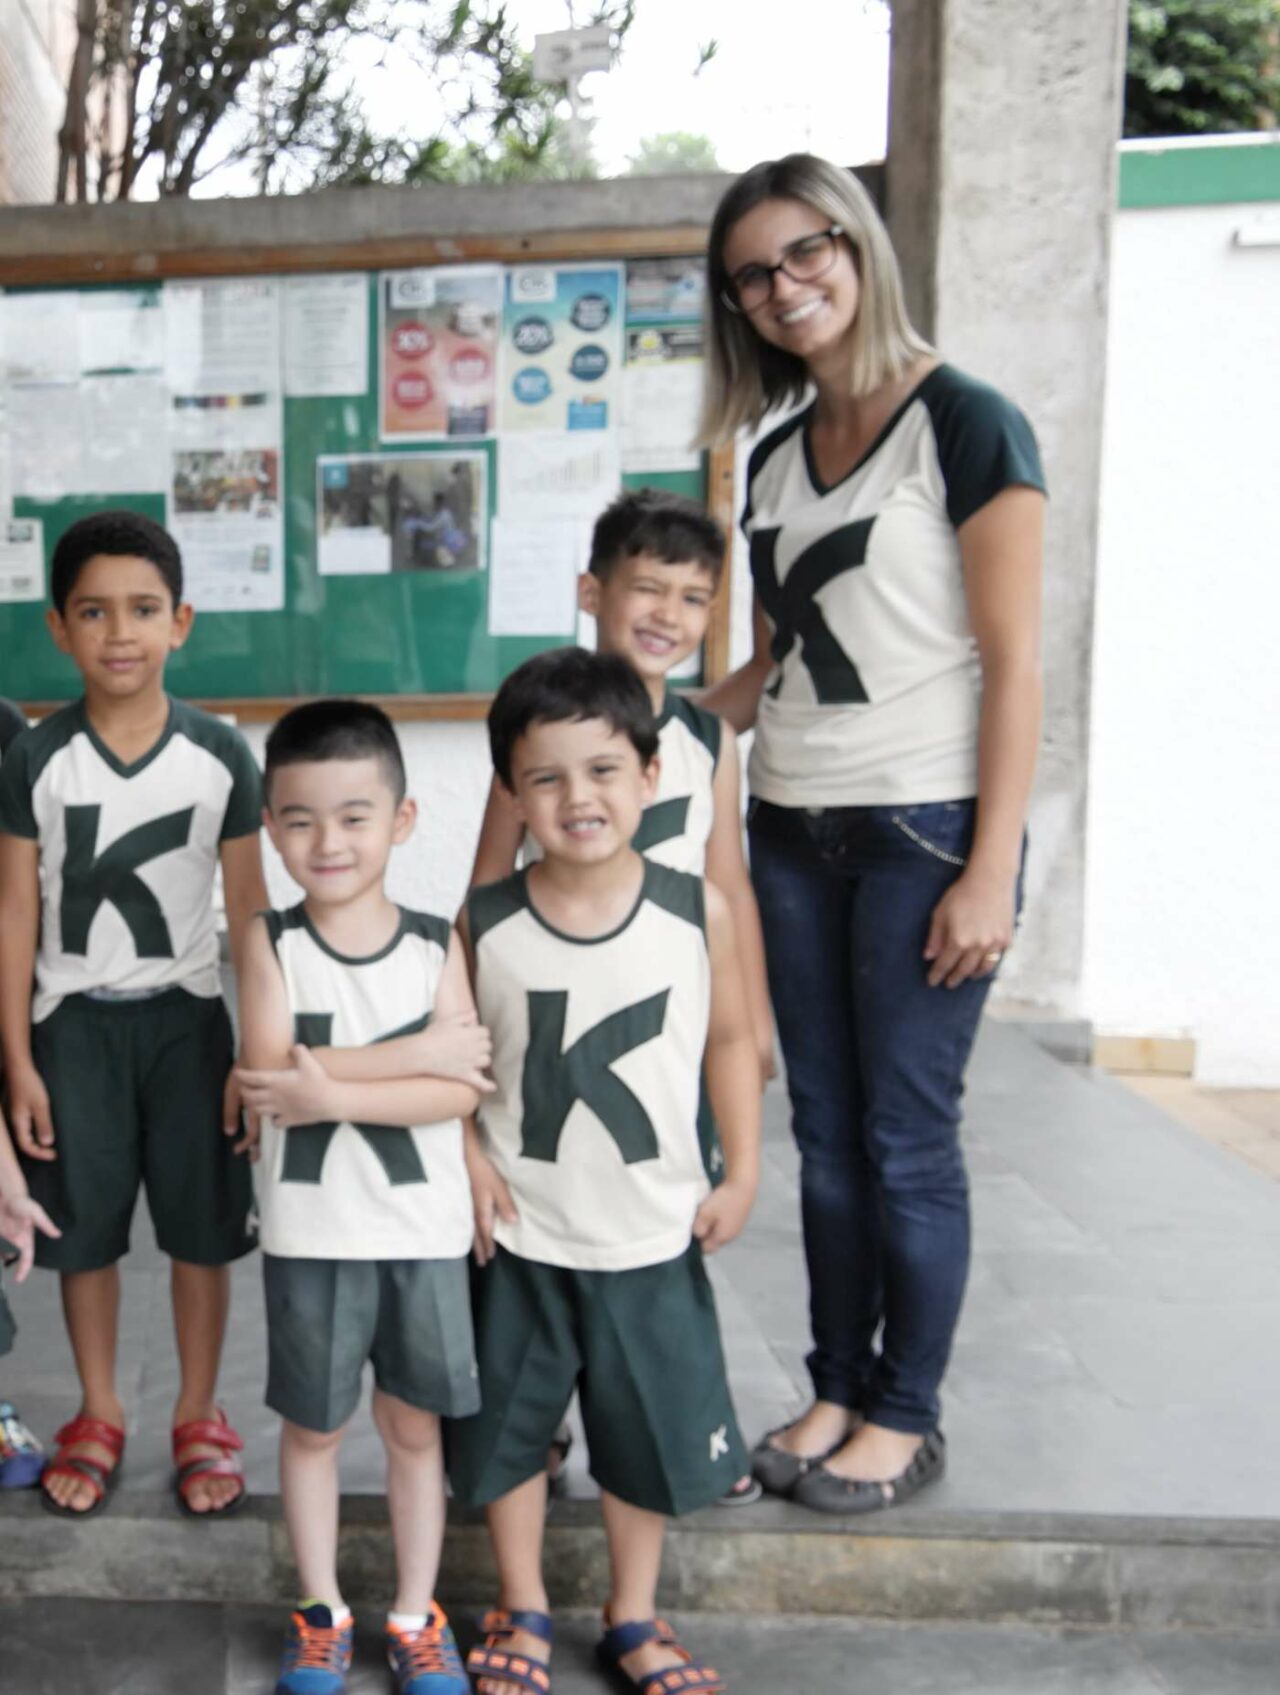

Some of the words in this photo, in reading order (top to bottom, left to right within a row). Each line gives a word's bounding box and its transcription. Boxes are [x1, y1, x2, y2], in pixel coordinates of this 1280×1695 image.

[750, 513, 880, 704] K
[60, 803, 197, 959] K
[518, 986, 672, 1165] K
[708, 1425, 729, 1462] K
